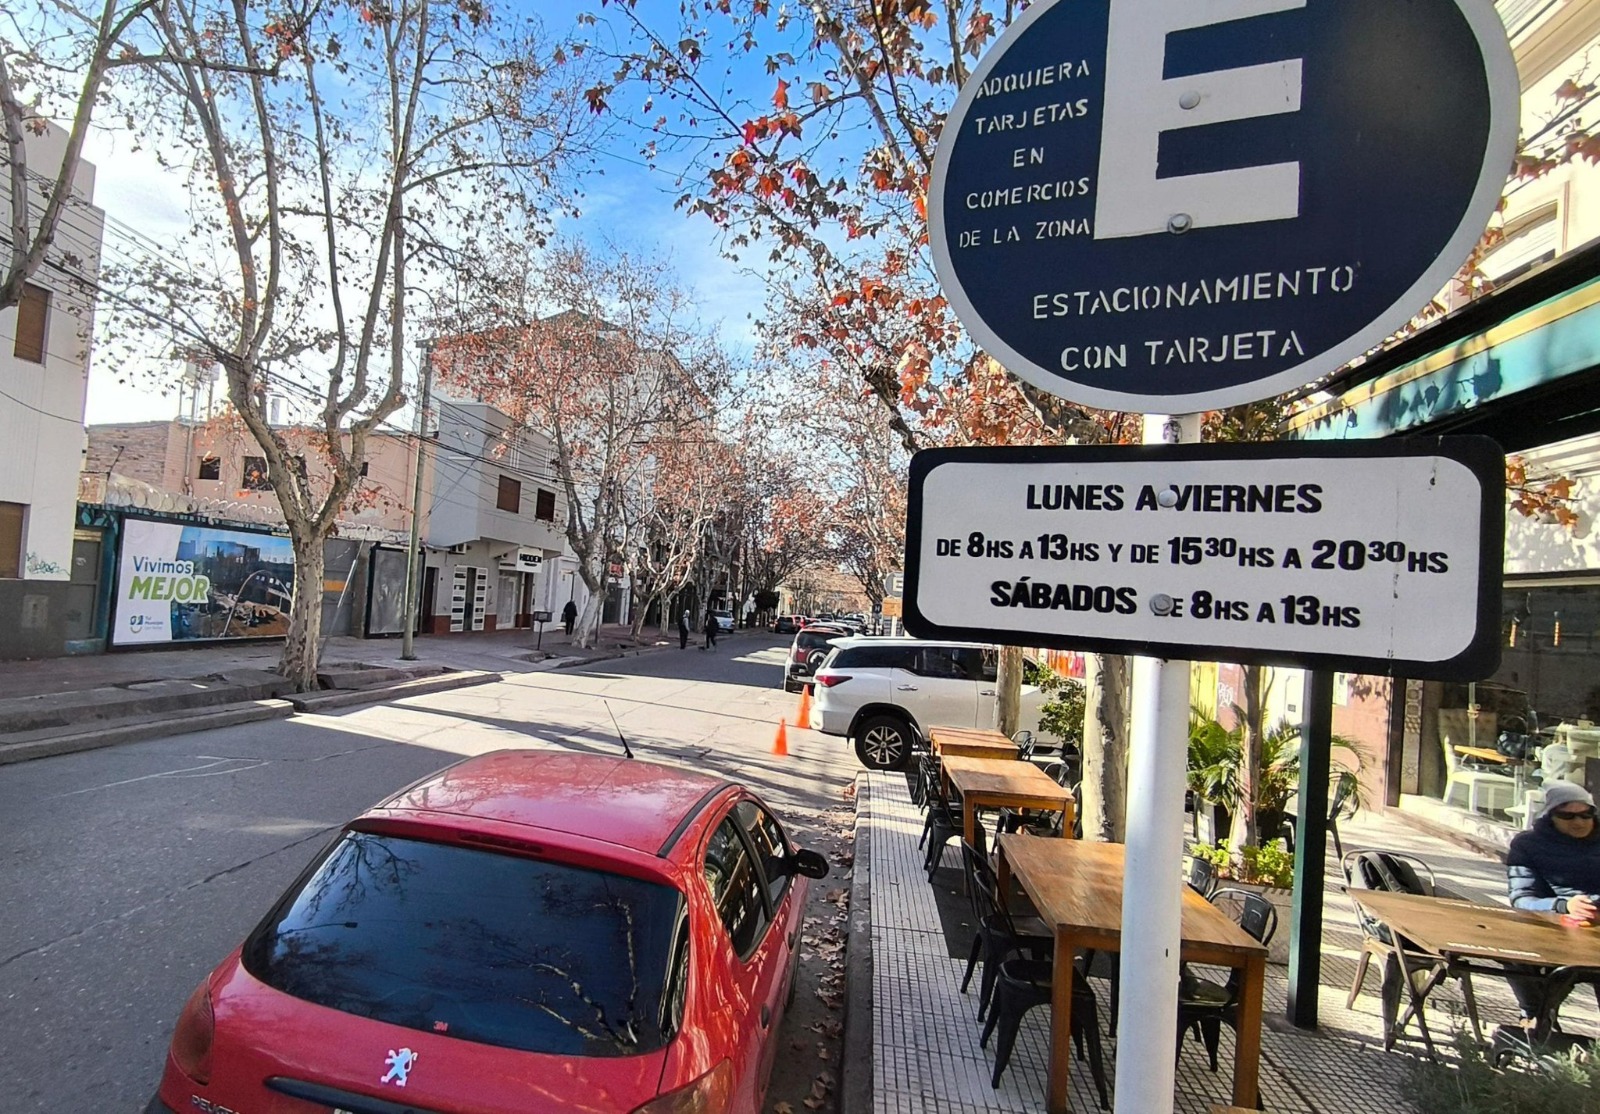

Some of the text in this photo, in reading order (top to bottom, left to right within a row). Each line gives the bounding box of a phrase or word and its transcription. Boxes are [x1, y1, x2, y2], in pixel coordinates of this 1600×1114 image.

[976, 59, 1090, 99] ADQUIERA
[975, 98, 1088, 135] TARJETAS
[1094, 0, 1306, 239] E
[1013, 147, 1044, 167] EN
[966, 177, 1090, 209] COMERCIOS
[959, 218, 1090, 248] DE LA ZONA
[1033, 265, 1354, 319] ESTACIONAMIENTO
[1060, 330, 1304, 371] CON TARJETA
[1026, 484, 1323, 513] LUNES A VIERNES
[132, 556, 193, 575] Vivimos
[936, 538, 961, 556] DE
[966, 531, 1014, 559] 8HS
[1019, 540, 1034, 559] A
[1037, 533, 1100, 562] 13HS
[1108, 543, 1123, 562] Y
[1130, 544, 1159, 564] DE
[1282, 548, 1302, 569] A
[129, 576, 208, 601] MEJOR
[892, 577, 903, 591] E
[990, 576, 1361, 628] SÁBADOS E 8HS A 13HS
